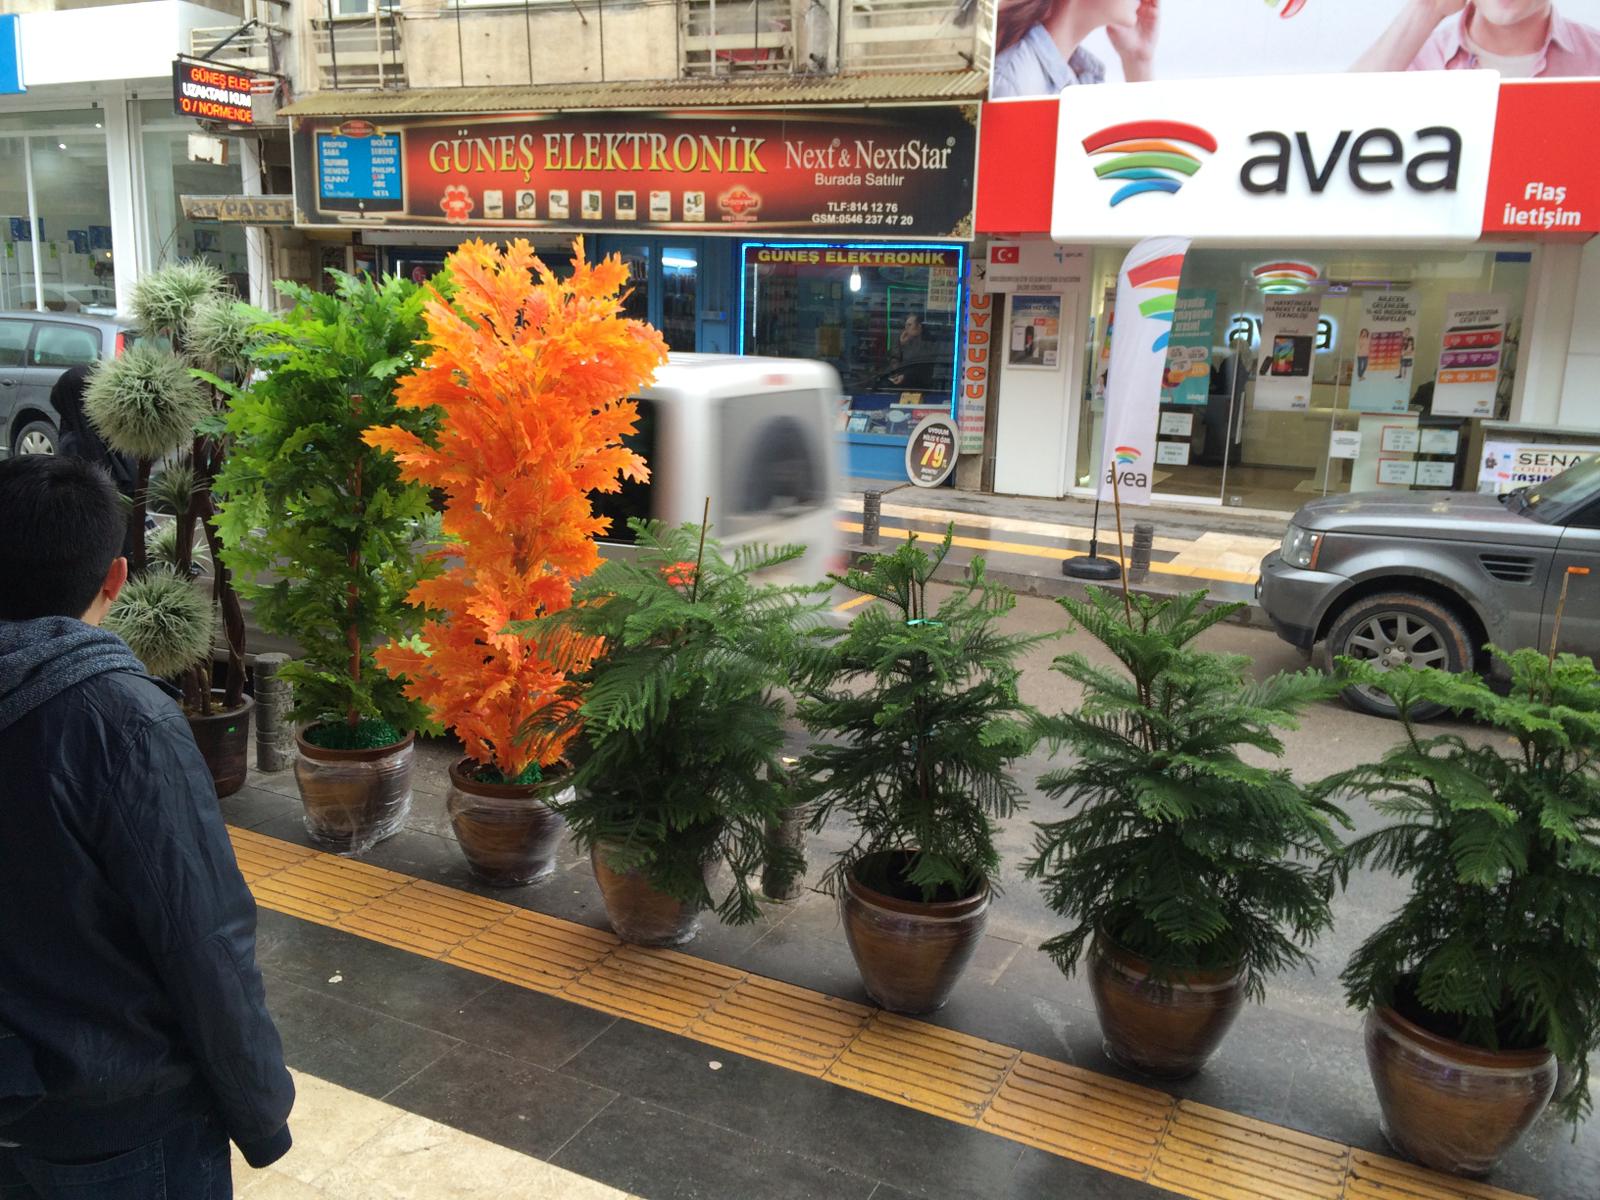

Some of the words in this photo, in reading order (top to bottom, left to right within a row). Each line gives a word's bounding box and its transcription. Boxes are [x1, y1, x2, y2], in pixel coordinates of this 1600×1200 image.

[191, 68, 226, 89] GÜNEŞ
[182, 82, 229, 104] UZAKTAN
[180, 98, 191, 112] O
[199, 103, 253, 122] NORMENDE
[429, 130, 535, 182] GÜNEŞ
[543, 126, 767, 173] ELEKTRONİK
[838, 152, 851, 167] &
[1238, 125, 1463, 194] avea
[815, 173, 861, 186] Burada
[865, 173, 904, 187] Satılır
[1524, 182, 1567, 204] Flaş
[827, 202, 868, 213] TLF:814
[871, 203, 883, 213] 12
[885, 203, 898, 213] 76
[1503, 203, 1582, 229] İletişim
[812, 213, 863, 225] GSM:0546
[865, 214, 882, 225] 237
[885, 215, 898, 225] 47
[901, 215, 913, 226] 20
[758, 249, 819, 265] GÜNEŞ
[825, 249, 945, 265] ELEKTRONİK
[966, 293, 991, 399] UYDUCU
[920, 441, 946, 468] 79
[1519, 453, 1582, 467] SENA
[1106, 469, 1147, 488] avea
